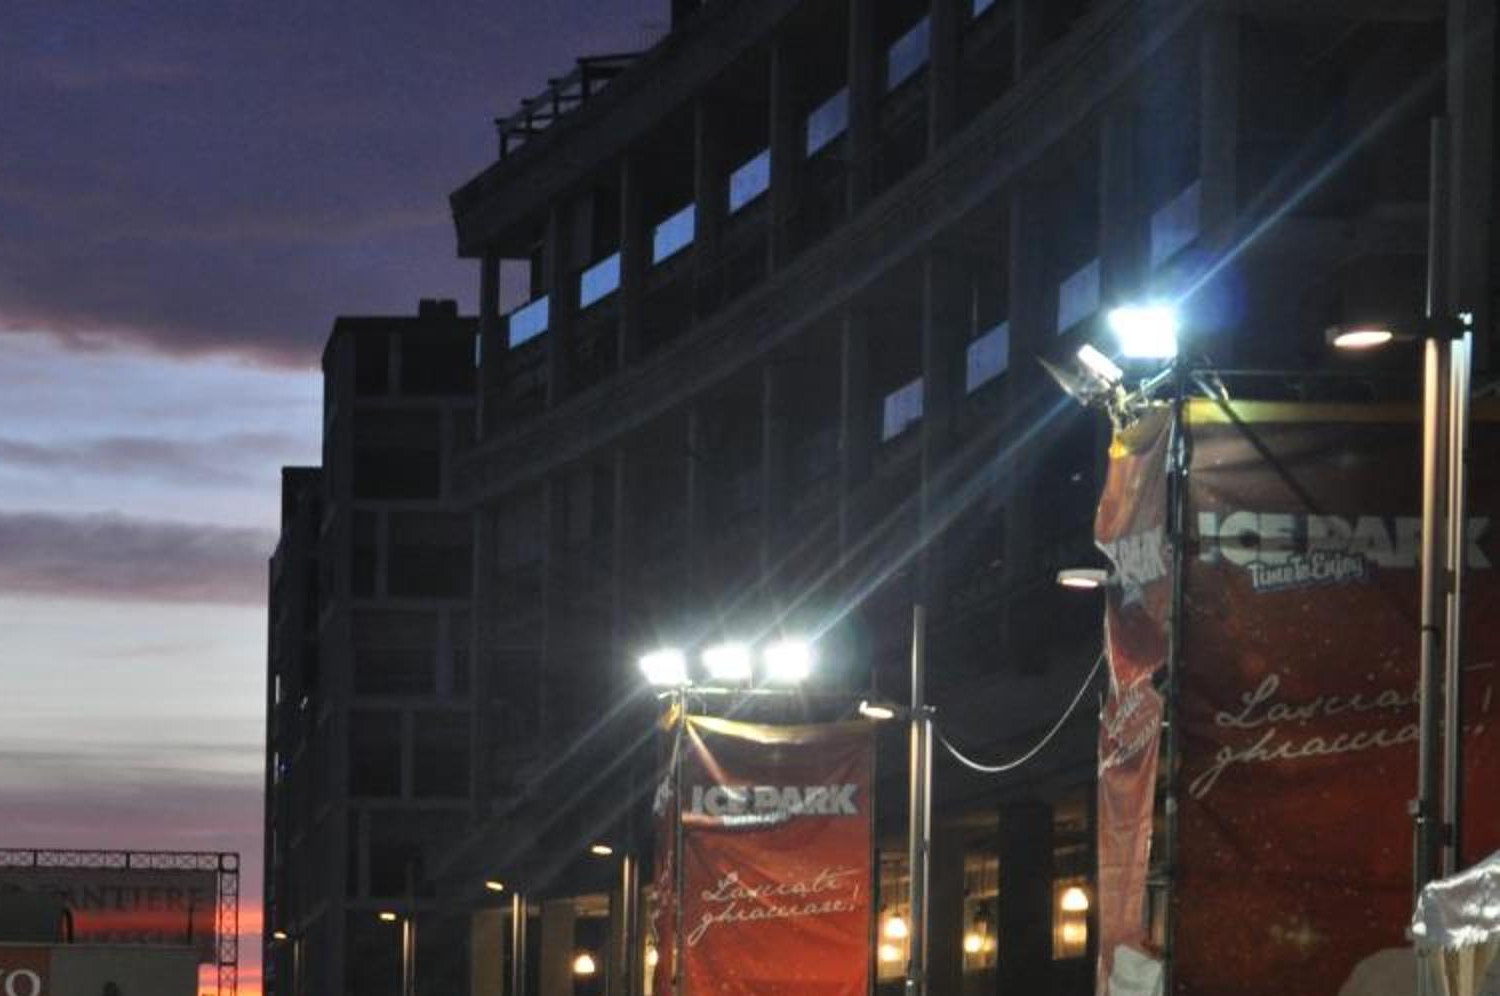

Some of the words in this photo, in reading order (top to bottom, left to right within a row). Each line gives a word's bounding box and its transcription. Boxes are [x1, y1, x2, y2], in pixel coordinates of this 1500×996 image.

[1198, 511, 1297, 566] ICE
[691, 785, 750, 816] ICE
[753, 784, 859, 815] PARK
